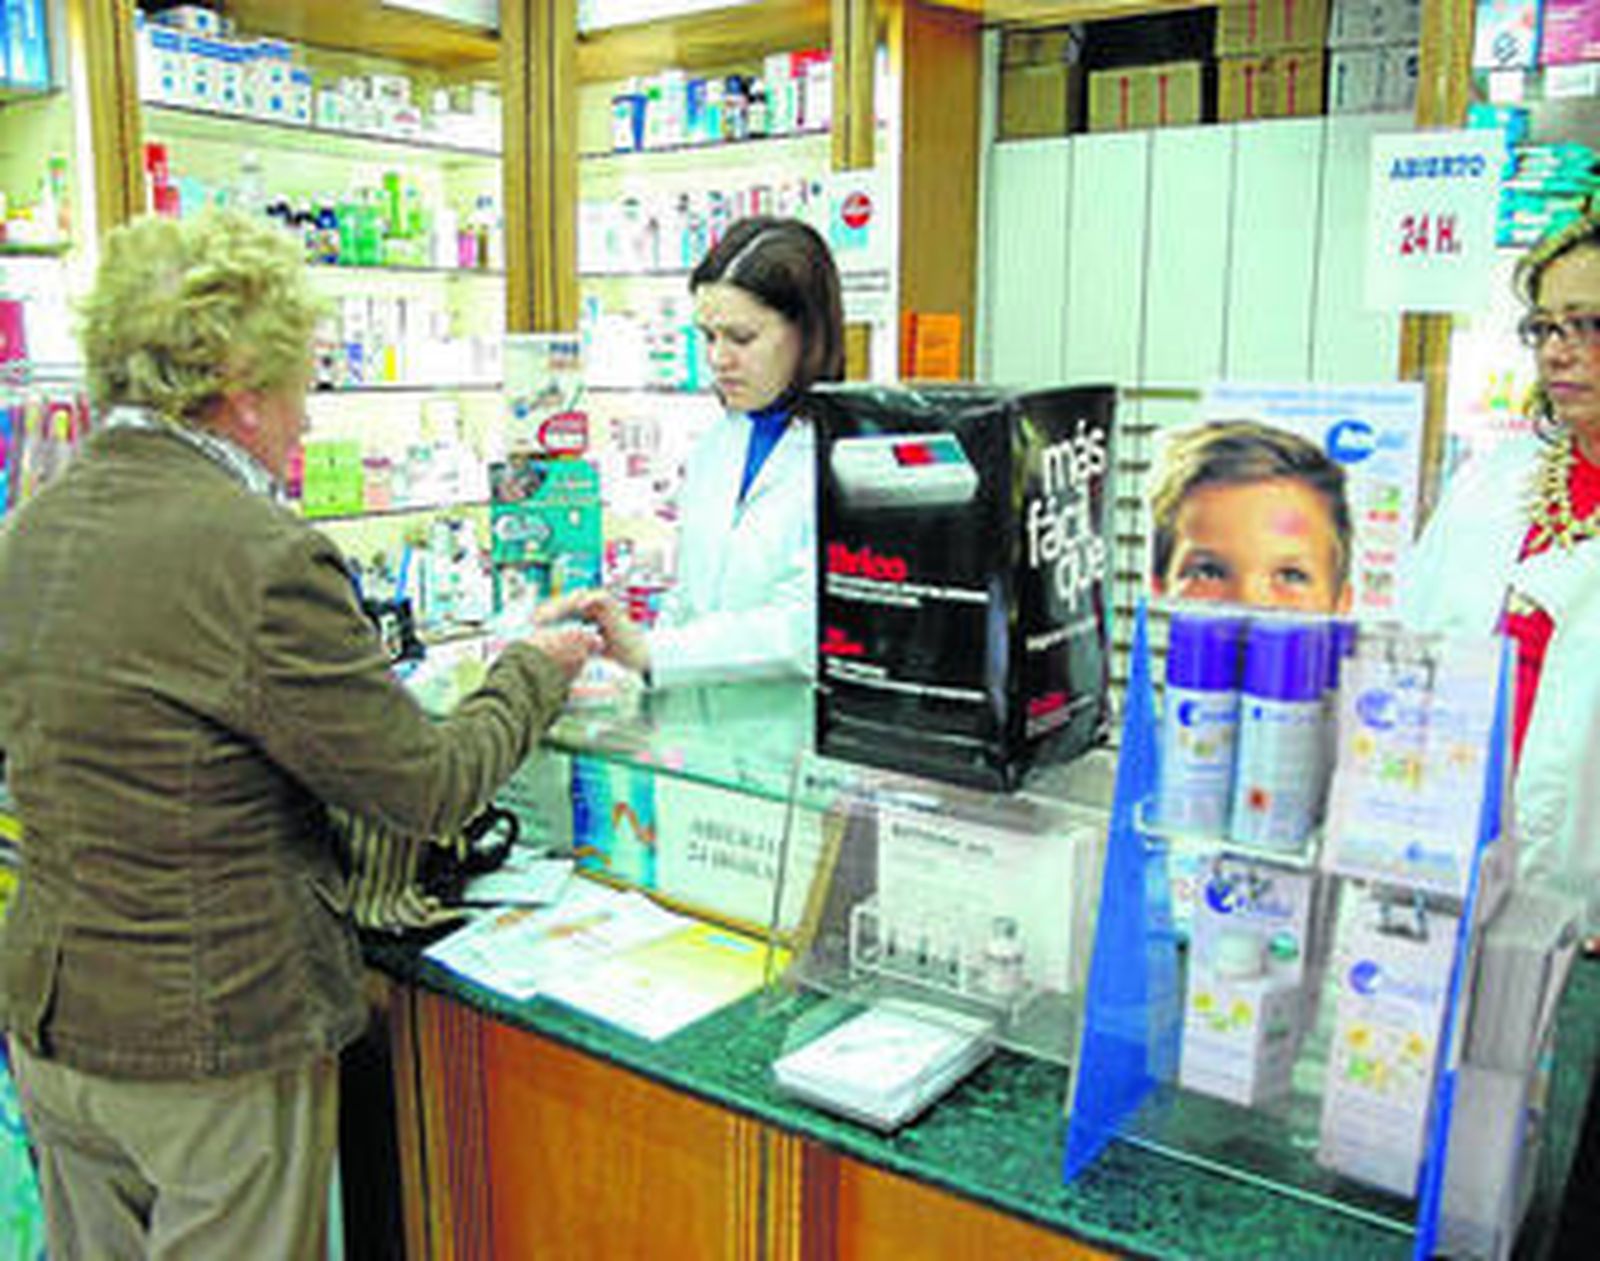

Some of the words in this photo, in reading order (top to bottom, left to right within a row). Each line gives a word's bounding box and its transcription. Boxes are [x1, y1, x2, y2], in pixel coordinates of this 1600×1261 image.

[1390, 154, 1486, 179] ABIERTO
[1400, 212, 1429, 255] 24
[1043, 418, 1107, 498] más
[1026, 481, 1092, 570] fácil
[1054, 536, 1107, 613] que
